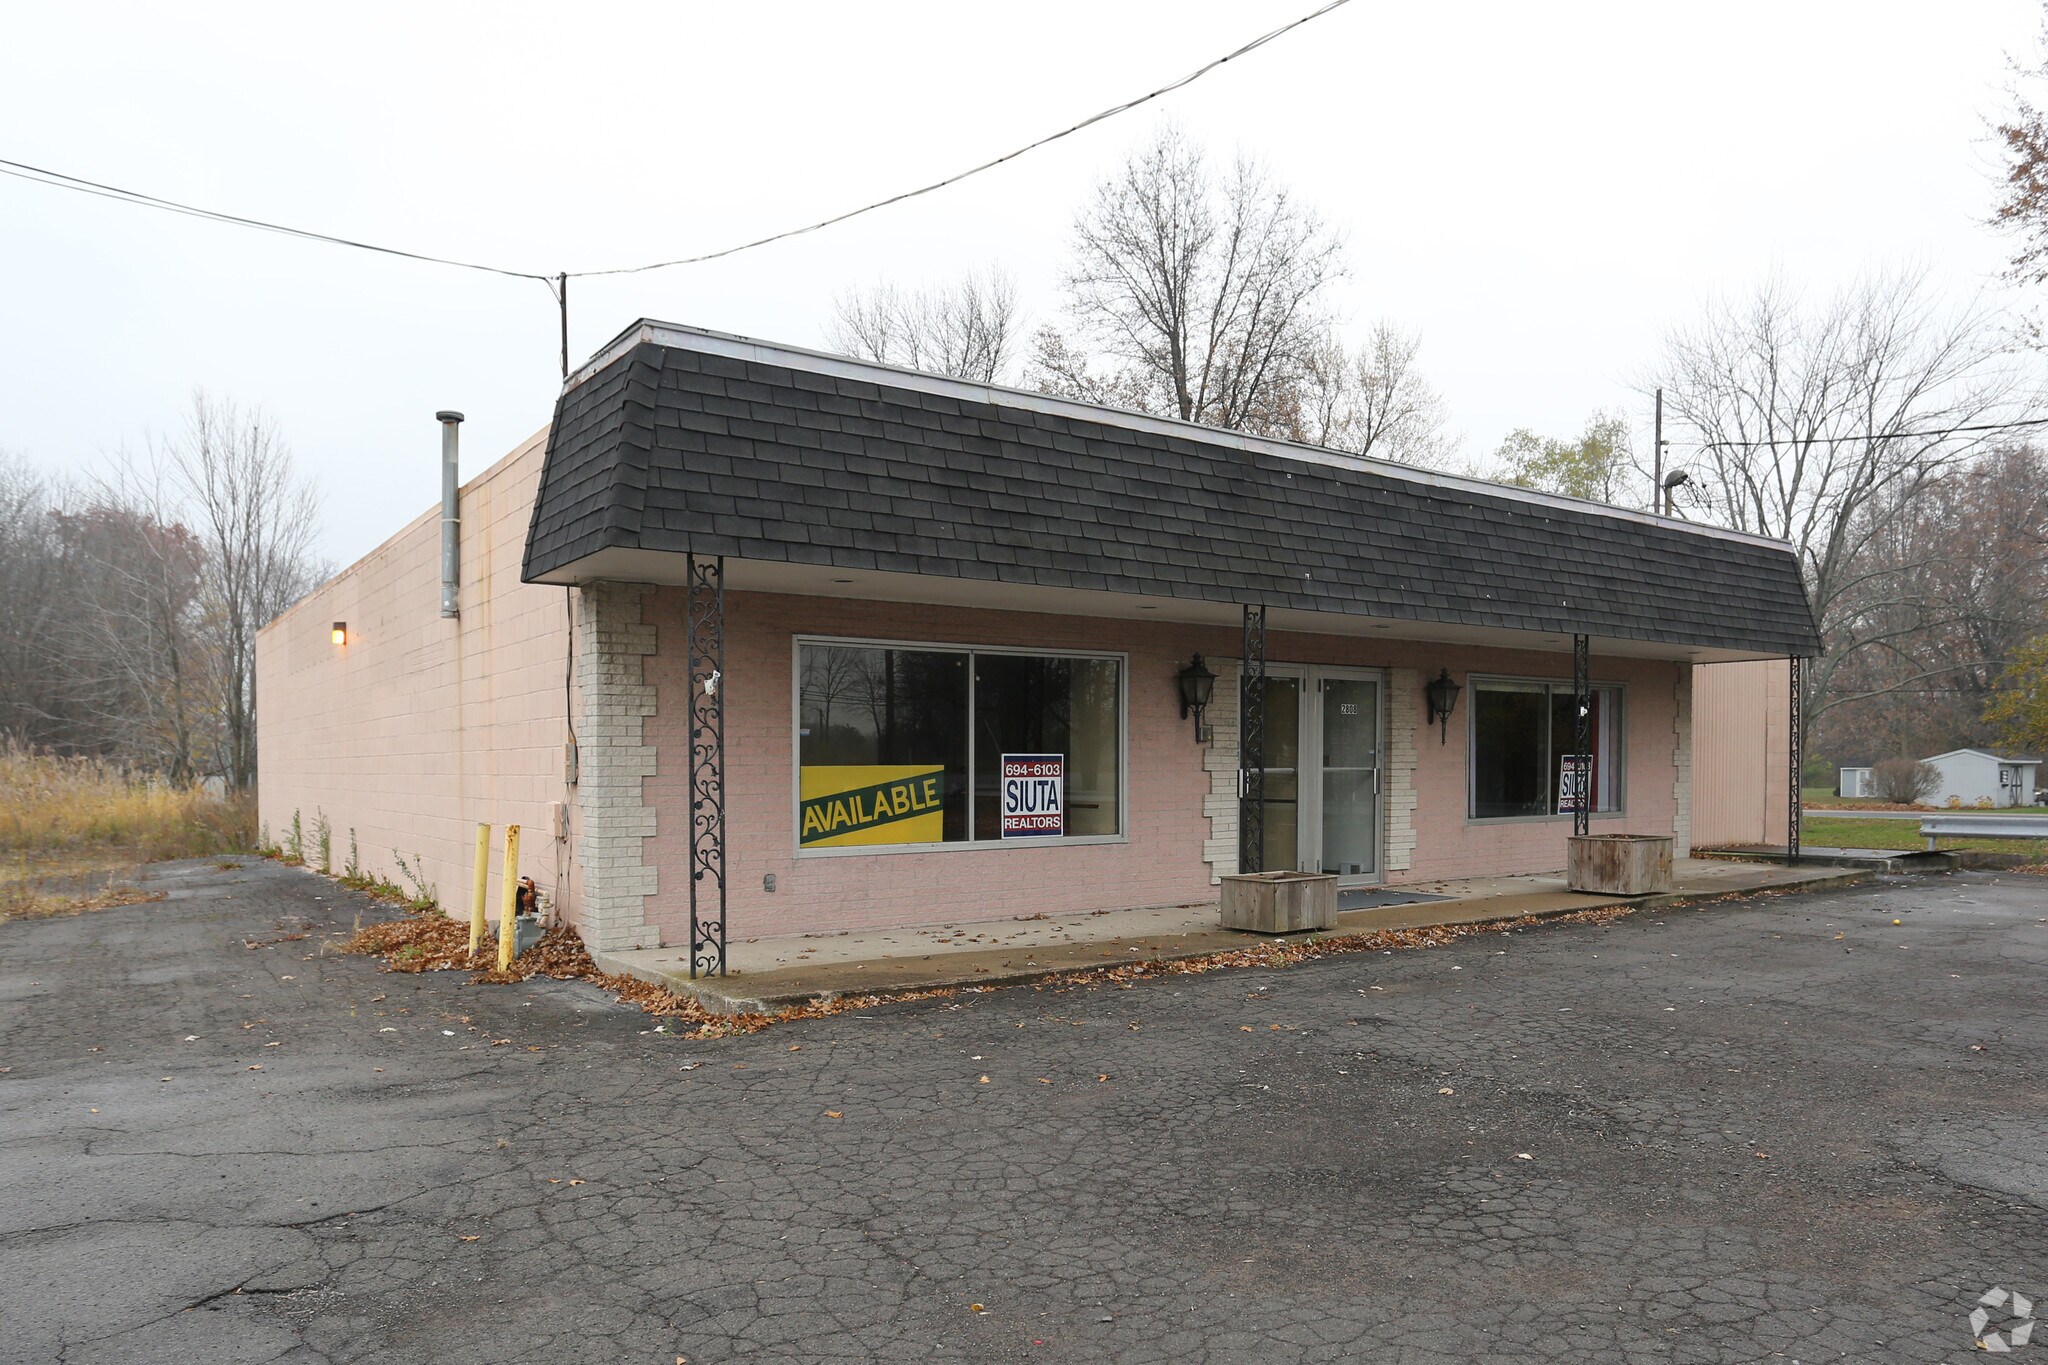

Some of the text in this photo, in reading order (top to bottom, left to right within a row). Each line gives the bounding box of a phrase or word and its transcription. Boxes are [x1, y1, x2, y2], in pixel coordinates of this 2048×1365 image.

[1005, 764, 1060, 776] 694-6103
[1563, 761, 1591, 771] 69413
[1562, 772, 1588, 797] SIU
[1006, 779, 1059, 813] SIUTA
[802, 778, 940, 837] AVAILABLE
[1560, 799, 1587, 808] REAL
[1004, 816, 1061, 829] REALTORS
